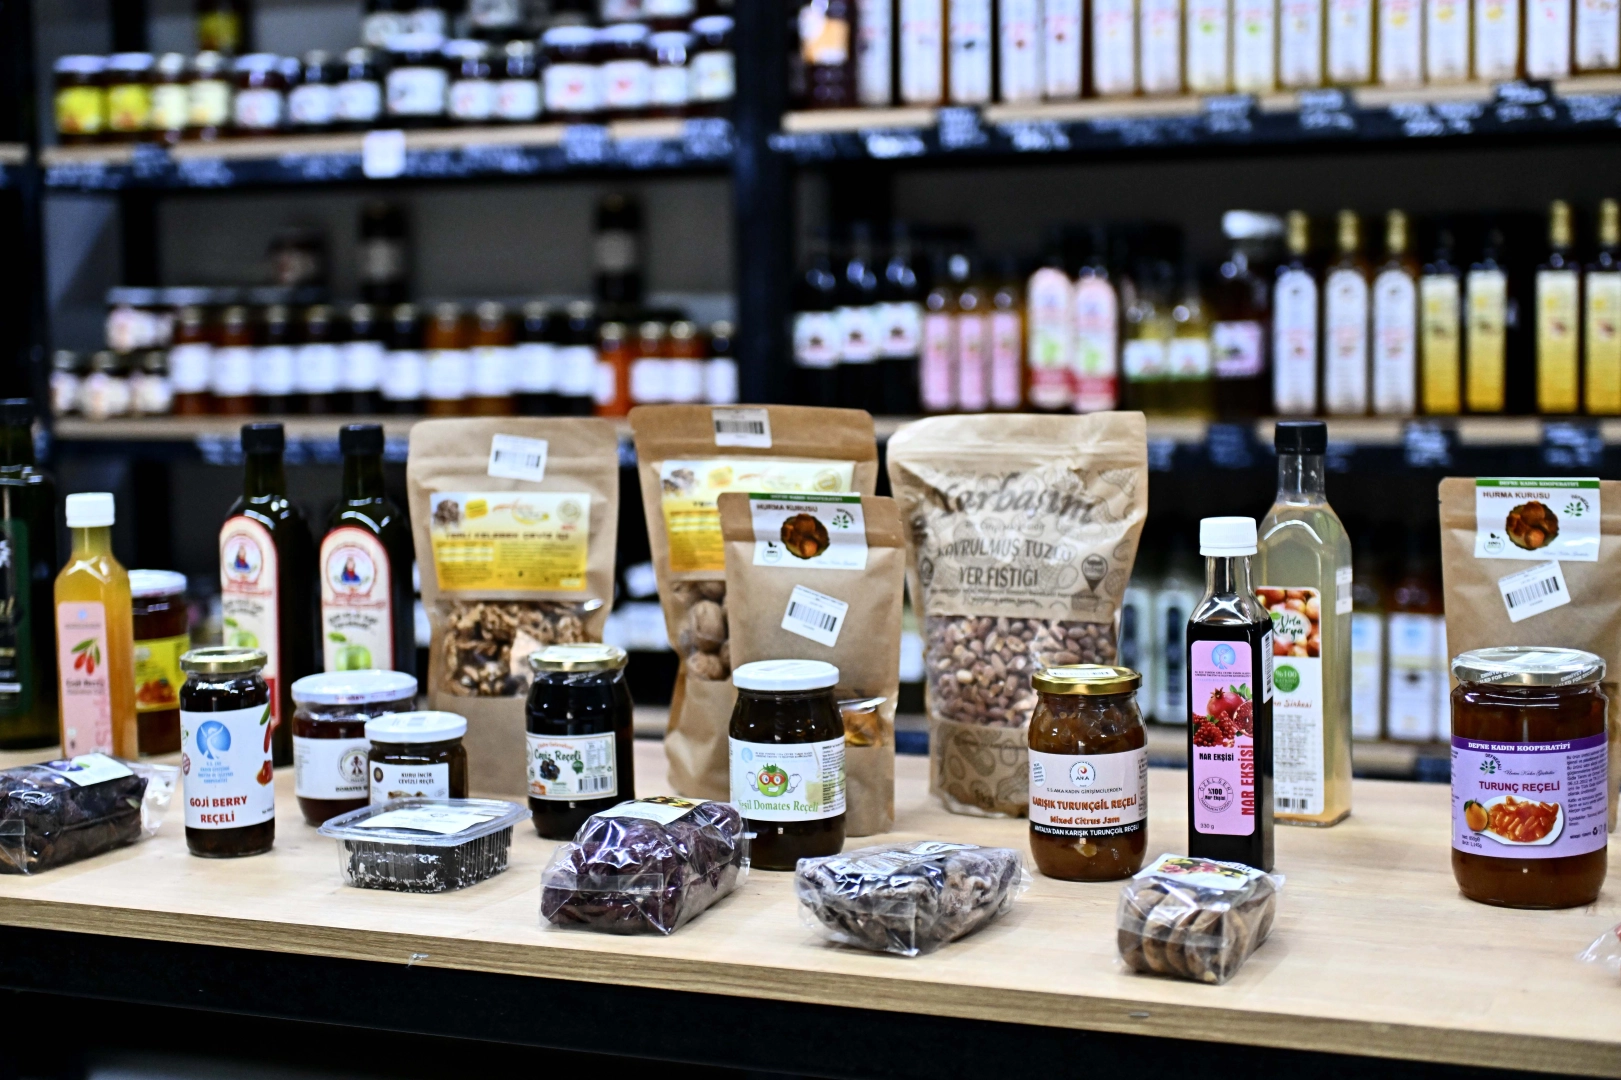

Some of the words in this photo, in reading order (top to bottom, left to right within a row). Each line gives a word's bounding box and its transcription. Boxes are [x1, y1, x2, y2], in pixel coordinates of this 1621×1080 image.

[959, 566, 983, 584] YER
[987, 565, 1038, 587] FISTIĞI
[1468, 742, 1490, 750] DEFNE
[1517, 742, 1571, 752] KOOPERATİFİ
[1213, 753, 1234, 761] EKŞİSİ
[1479, 781, 1519, 793] TURUNÇ
[1522, 781, 1560, 793] REÇELİ
[189, 796, 209, 808] GOJİ
[212, 795, 248, 808] BERRY
[753, 800, 791, 811] Domates
[793, 800, 819, 814] Reçeli
[1032, 796, 1056, 810] KARIŞIK
[1057, 799, 1110, 813] TURUNÇGİL
[1111, 794, 1137, 810] REÇELİ
[1241, 791, 1255, 815] NAR
[200, 810, 235, 826] REÇELİ
[1050, 816, 1073, 825] Mixed
[1074, 817, 1101, 825] Citrus
[1102, 815, 1121, 825] Jam
[1065, 829, 1089, 838] KARIŞIK
[1090, 827, 1124, 837] TURUNÇGİL
[1124, 823, 1140, 833] REÇELİ
